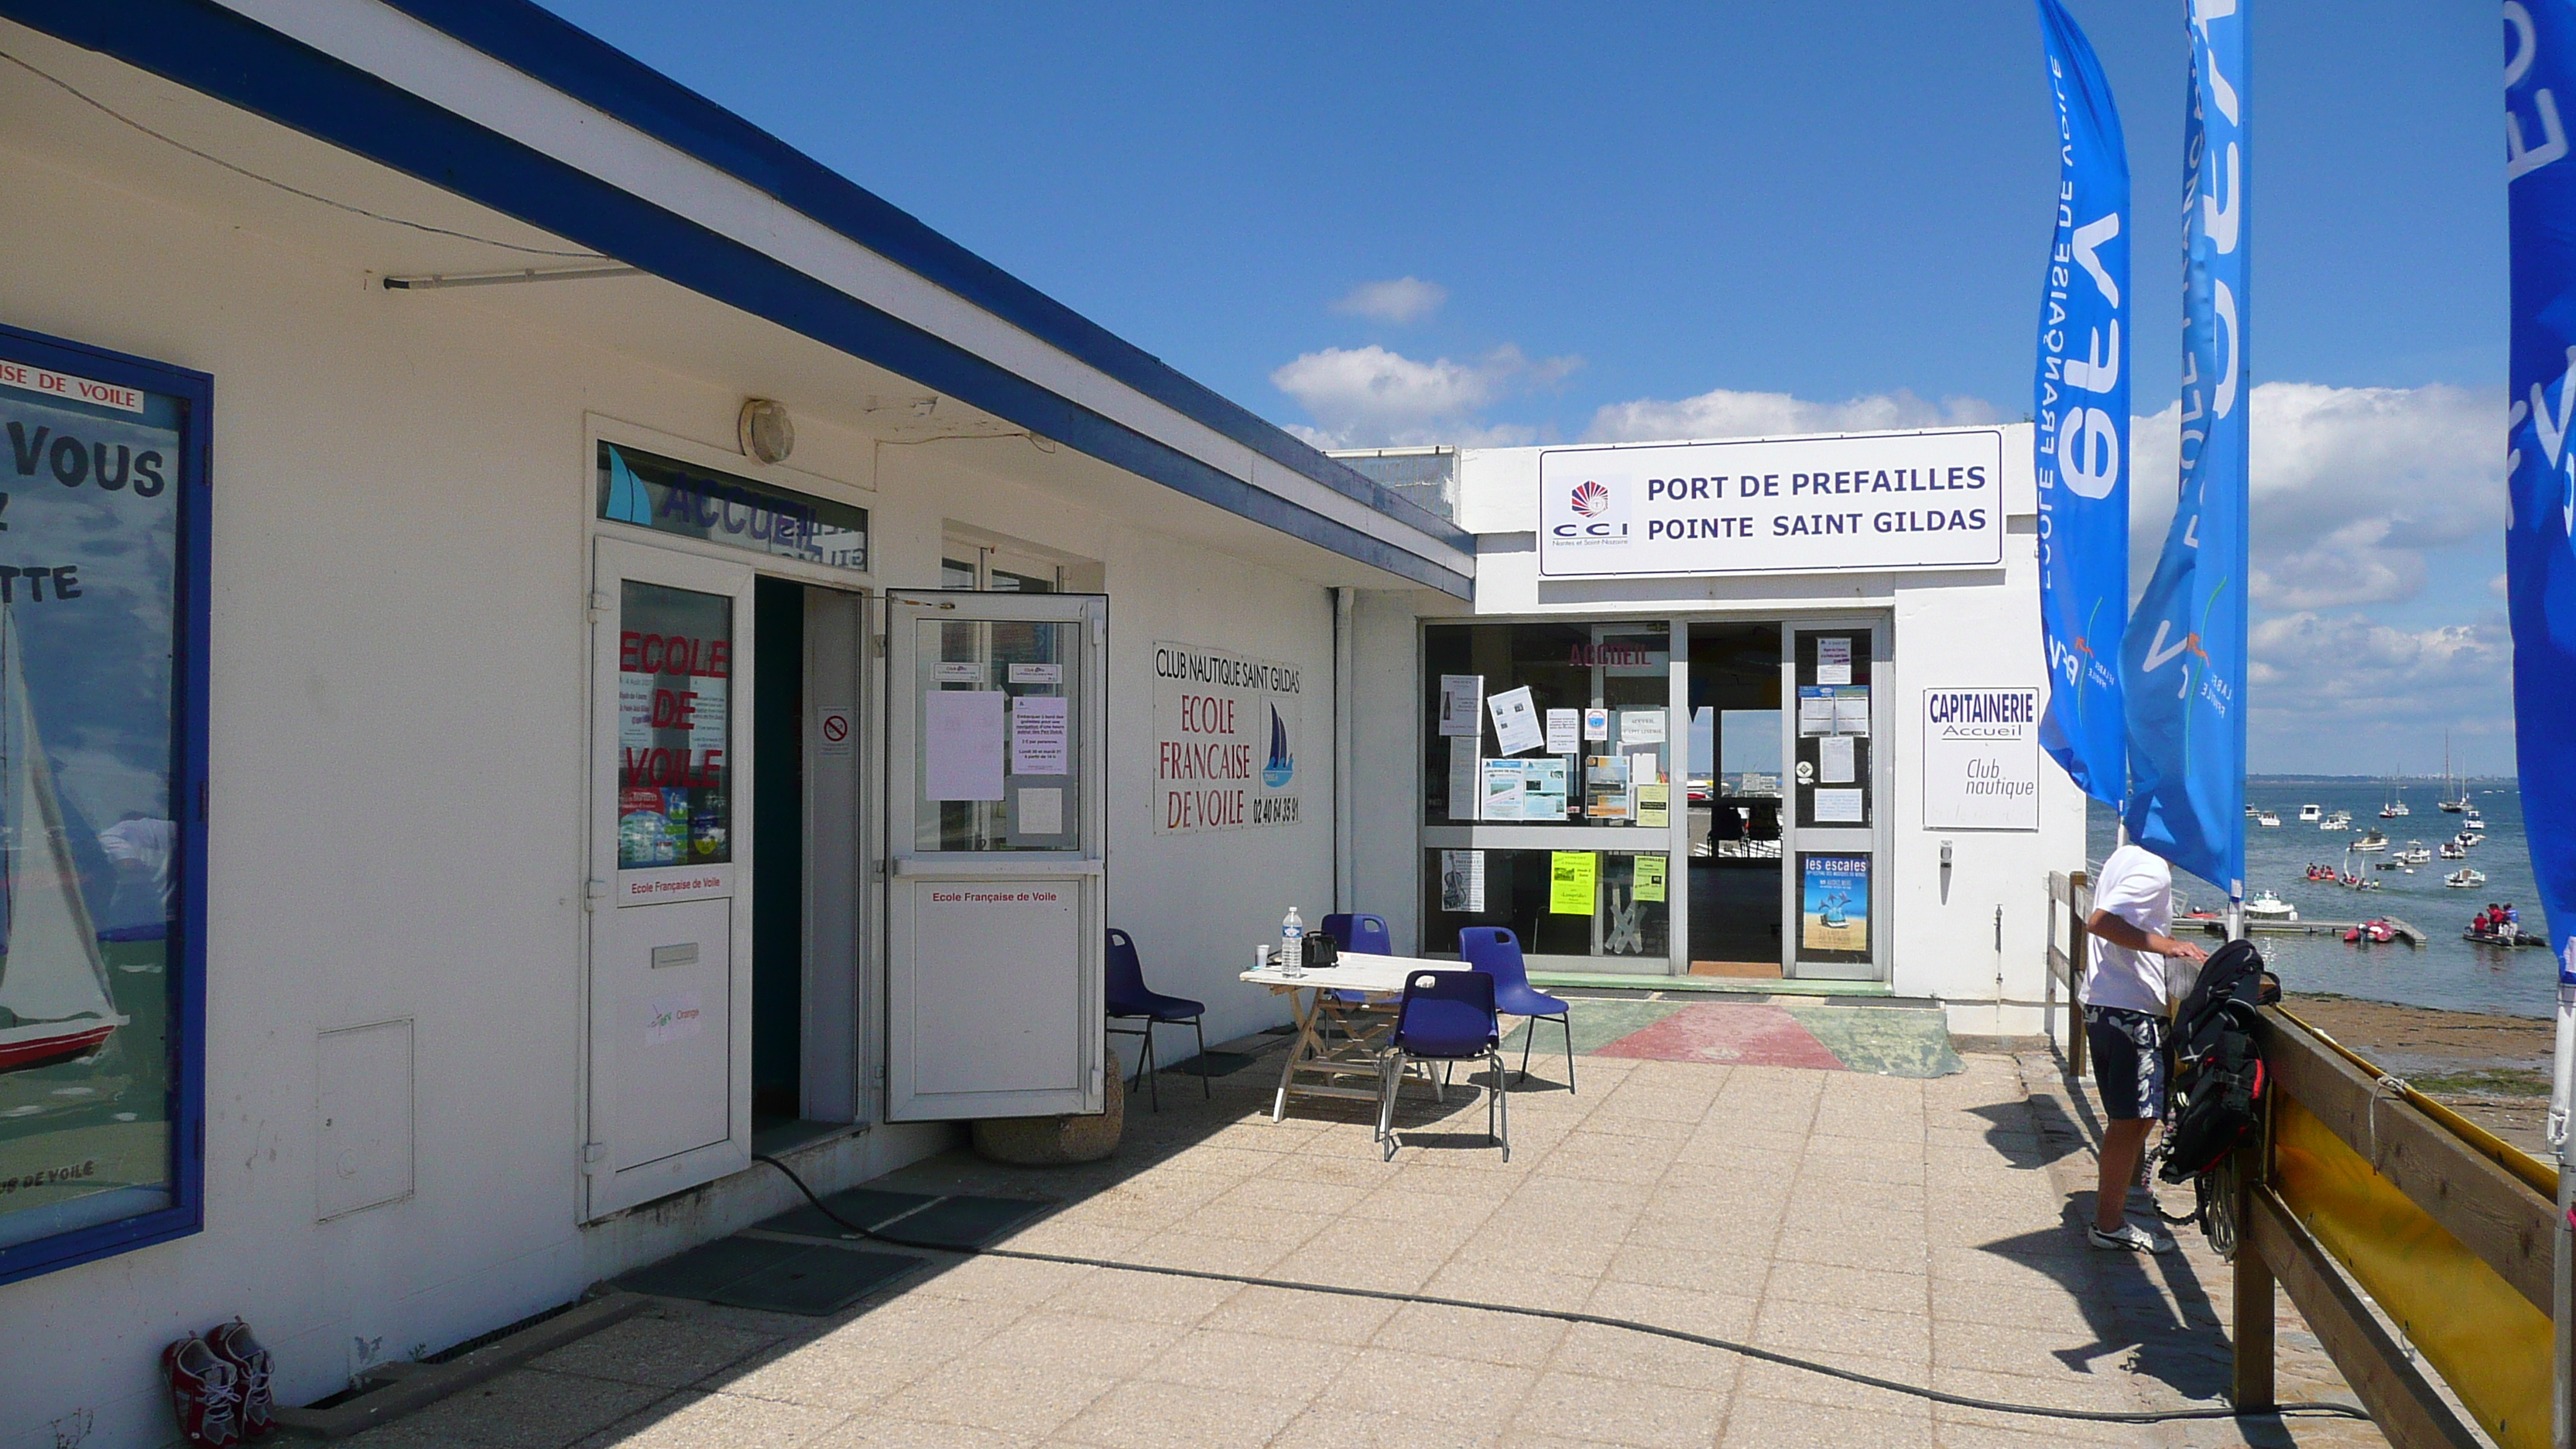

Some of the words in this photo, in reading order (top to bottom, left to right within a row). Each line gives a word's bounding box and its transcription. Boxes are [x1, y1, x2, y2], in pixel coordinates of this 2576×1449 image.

[39, 373, 67, 393] DE
[79, 382, 136, 408] VOILE
[6, 420, 165, 498] VOUS
[1647, 475, 1728, 501] PORT
[1741, 473, 1780, 498] DE
[1792, 465, 1986, 496] PREFAILLES
[661, 471, 824, 554] ACCUEIL
[1648, 516, 1755, 540] POINTE
[1773, 512, 1863, 537] SAINT
[1874, 509, 1986, 533] GILDAS
[1553, 523, 1628, 536] CCI
[620, 630, 731, 679] ECOLE
[1569, 644, 1653, 666] ACCUEIL
[1156, 648, 1187, 680] CLUB
[1189, 652, 1240, 687] NAUTIQUE
[1242, 662, 1269, 690] SAINT
[1271, 666, 1300, 694] GILDAS
[652, 688, 699, 731] DE
[1181, 694, 1235, 735] ECOLE
[1930, 694, 2033, 724] CAPITAINERIE
[1943, 724, 2022, 736] Accueil
[625, 746, 723, 788] VOILE
[1160, 741, 1251, 779] FRANCAISE
[1967, 758, 2000, 779] Club
[1966, 777, 2034, 800] nautique
[1167, 790, 1192, 829] DE
[1196, 789, 1244, 827] VOILE
[1253, 798, 1262, 824] 02
[1263, 798, 1273, 824] 40
[1273, 798, 1281, 823] 64
[1282, 797, 1291, 823] 35
[1291, 796, 1299, 821] 91
[1806, 858, 1822, 871] les
[1825, 859, 1866, 872] escales
[632, 883, 653, 894] Ecole
[655, 879, 690, 892] Française
[692, 879, 701, 888] de
[703, 877, 721, 887] Voile
[933, 892, 961, 902] Ecole
[964, 892, 1014, 903] Française
[1016, 892, 1029, 901] de
[1032, 892, 1057, 901] Voile
[22, 1171, 45, 1189] DE
[48, 1160, 94, 1183] VOILE
